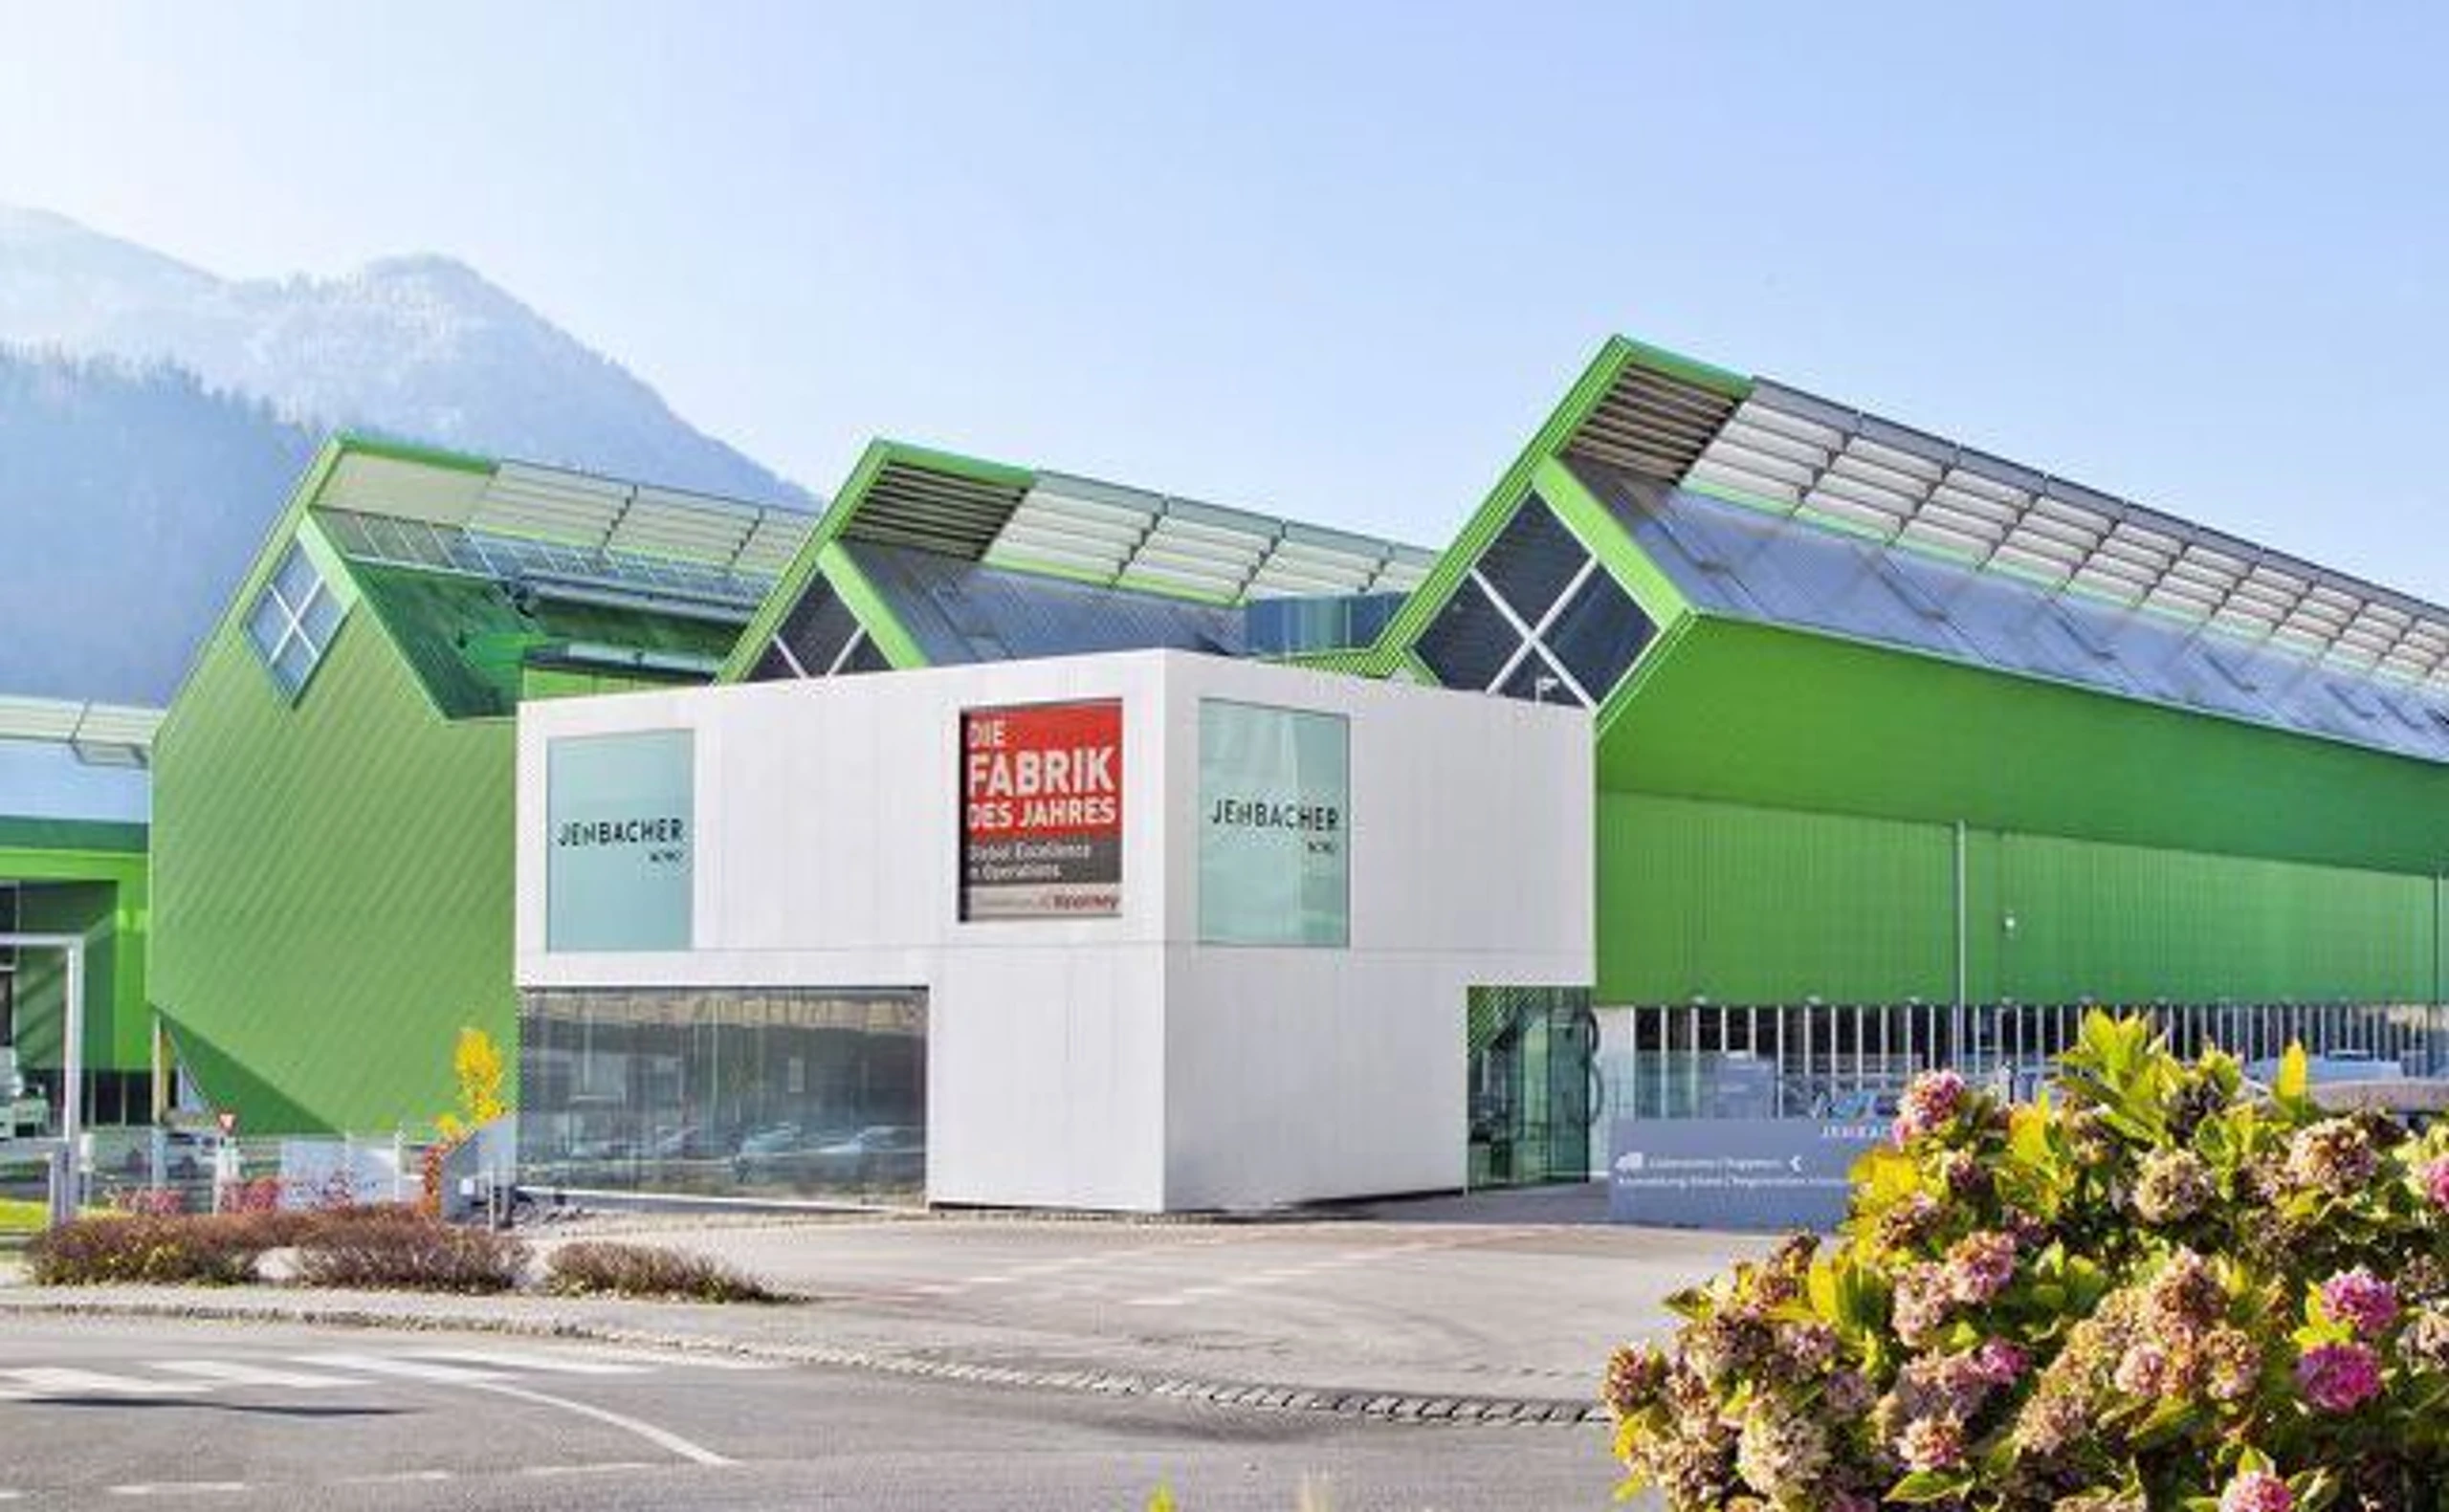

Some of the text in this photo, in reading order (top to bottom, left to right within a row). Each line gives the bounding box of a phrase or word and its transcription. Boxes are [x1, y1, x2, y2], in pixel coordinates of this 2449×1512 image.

[968, 720, 1005, 748] DIE
[968, 745, 1115, 798] FABRIK
[968, 796, 1116, 829] DES JAHRES
[1210, 800, 1339, 831] JENBACHER
[558, 817, 685, 847] JENBACHER
